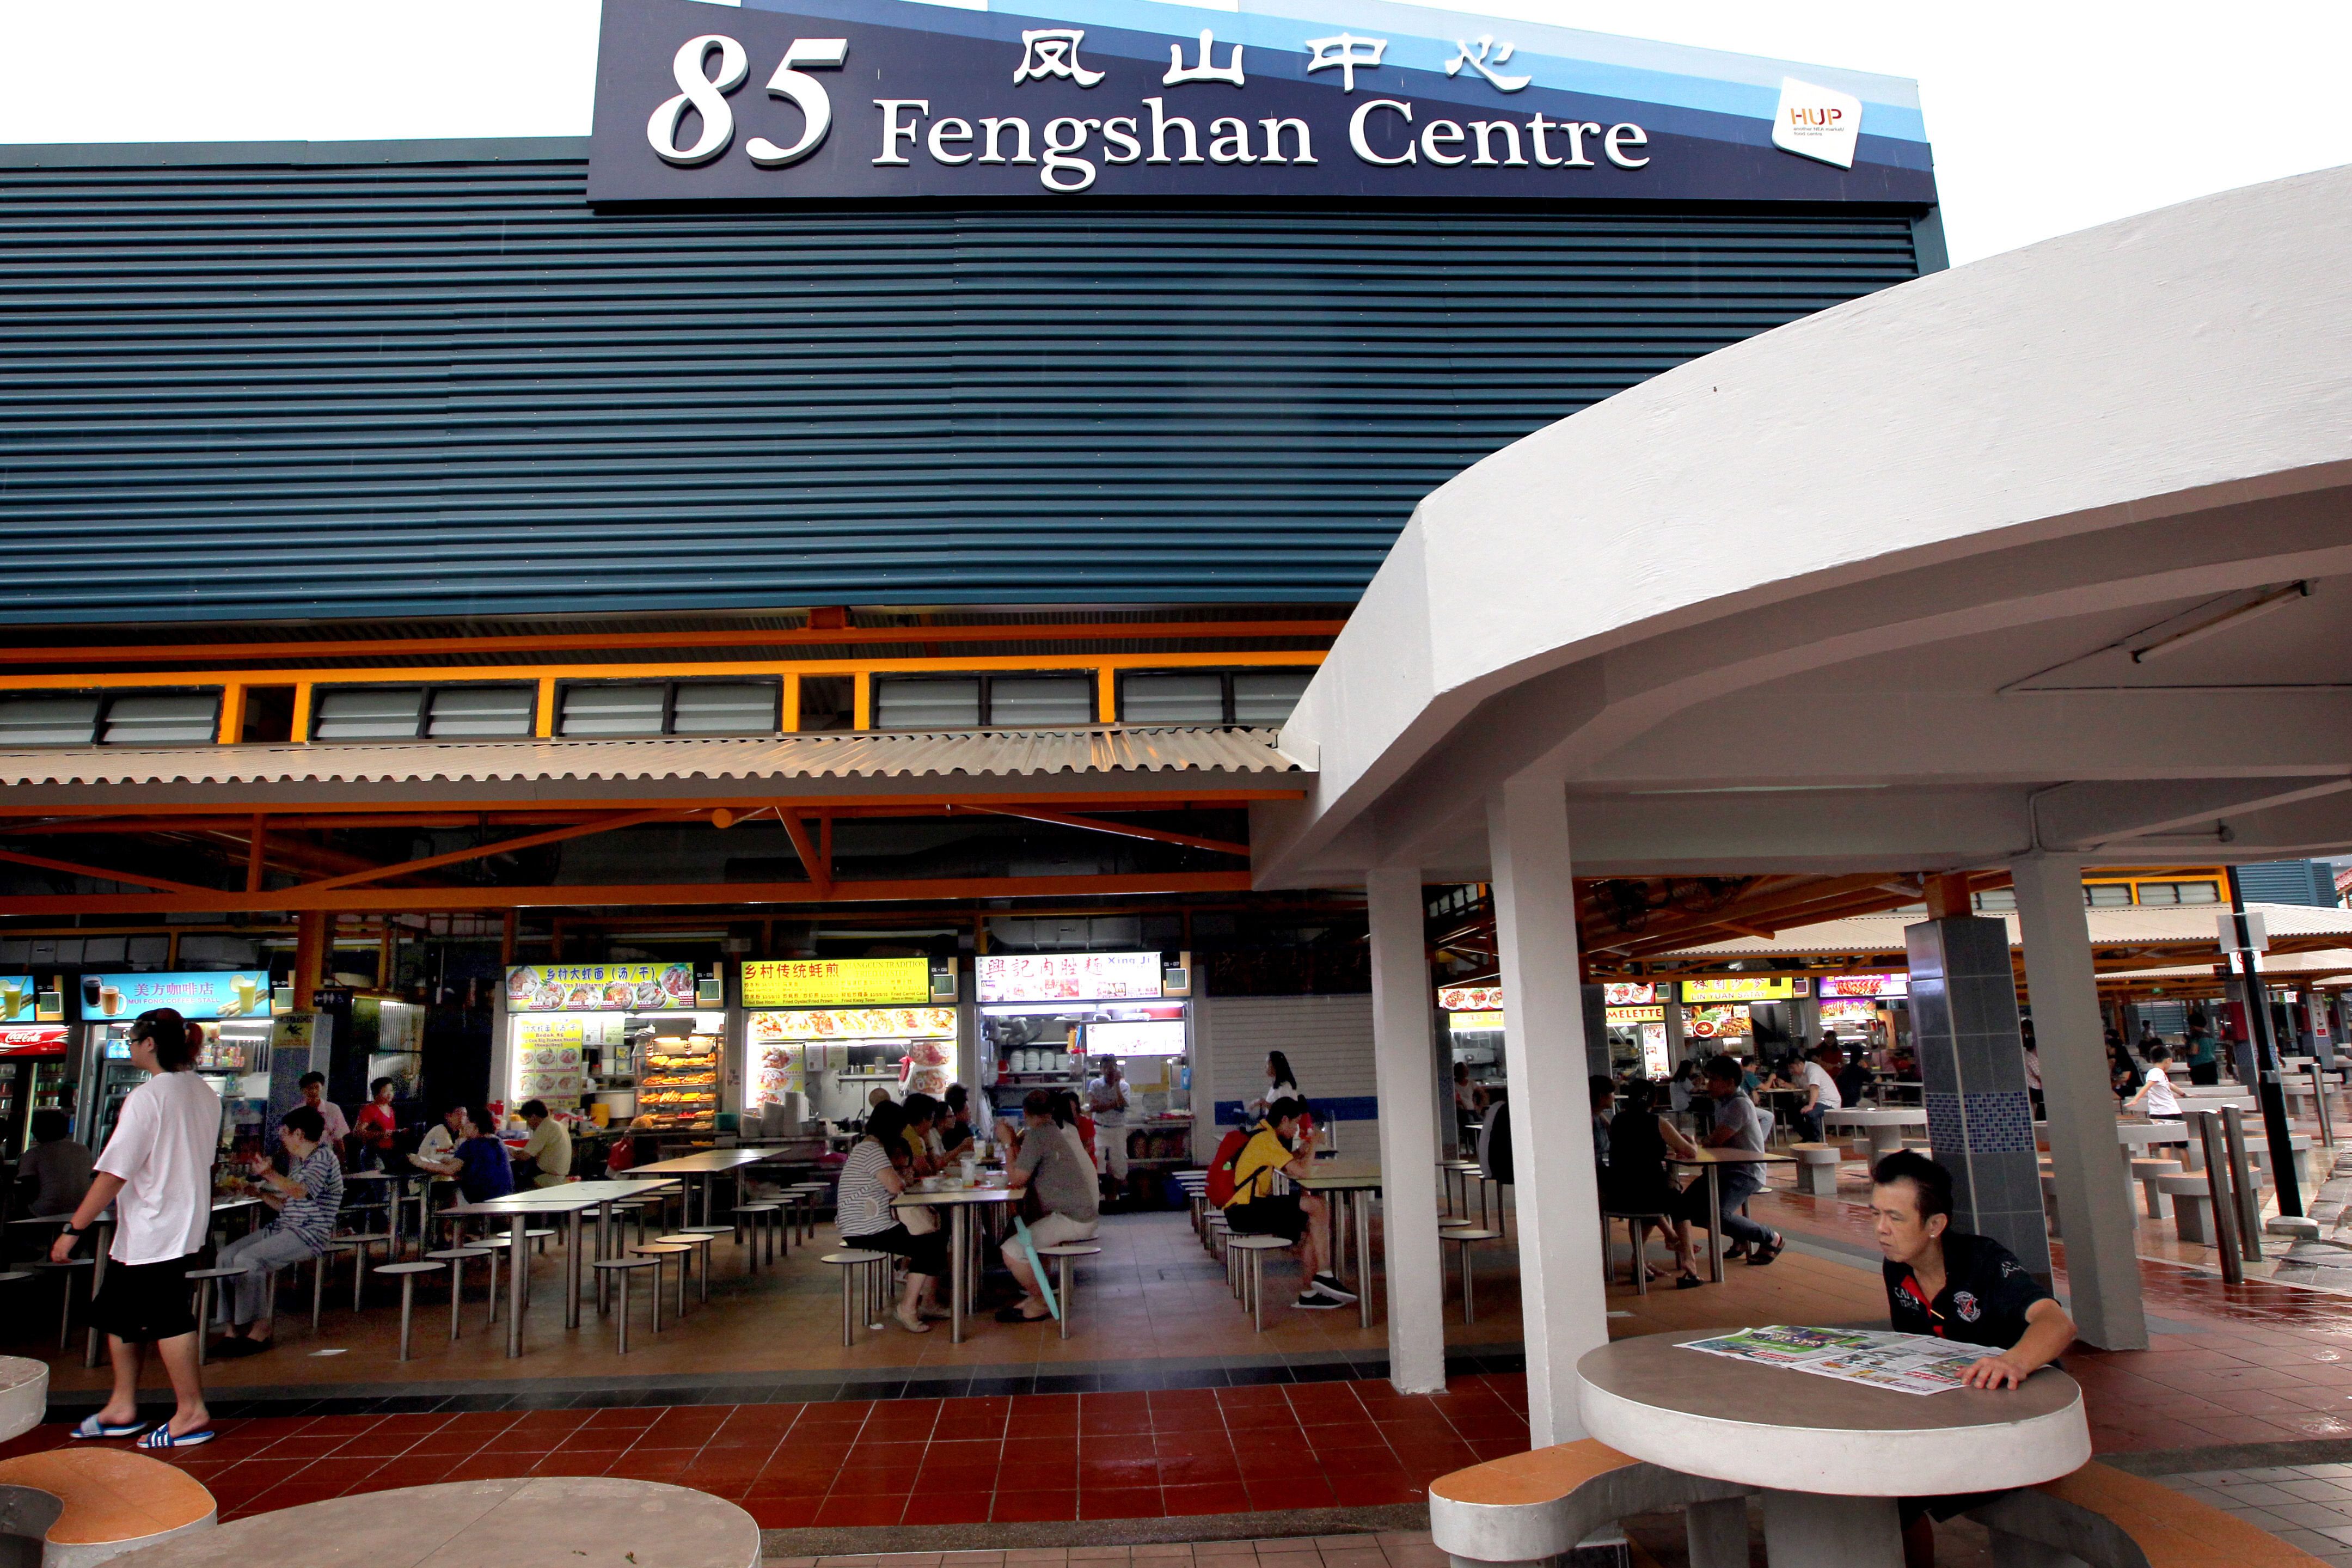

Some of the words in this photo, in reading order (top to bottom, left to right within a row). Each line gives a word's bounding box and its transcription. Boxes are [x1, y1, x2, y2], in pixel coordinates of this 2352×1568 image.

[647, 34, 849, 166] 85
[1790, 108, 1842, 125] HUP
[872, 97, 1318, 192] Fengshan
[1349, 99, 1650, 169] Centre
[1107, 957, 1135, 965] Xing
[1140, 955, 1150, 964] Ji
[745, 963, 839, 979] 乡村传统蚝煎
[134, 982, 214, 996] 美方咖啡店
